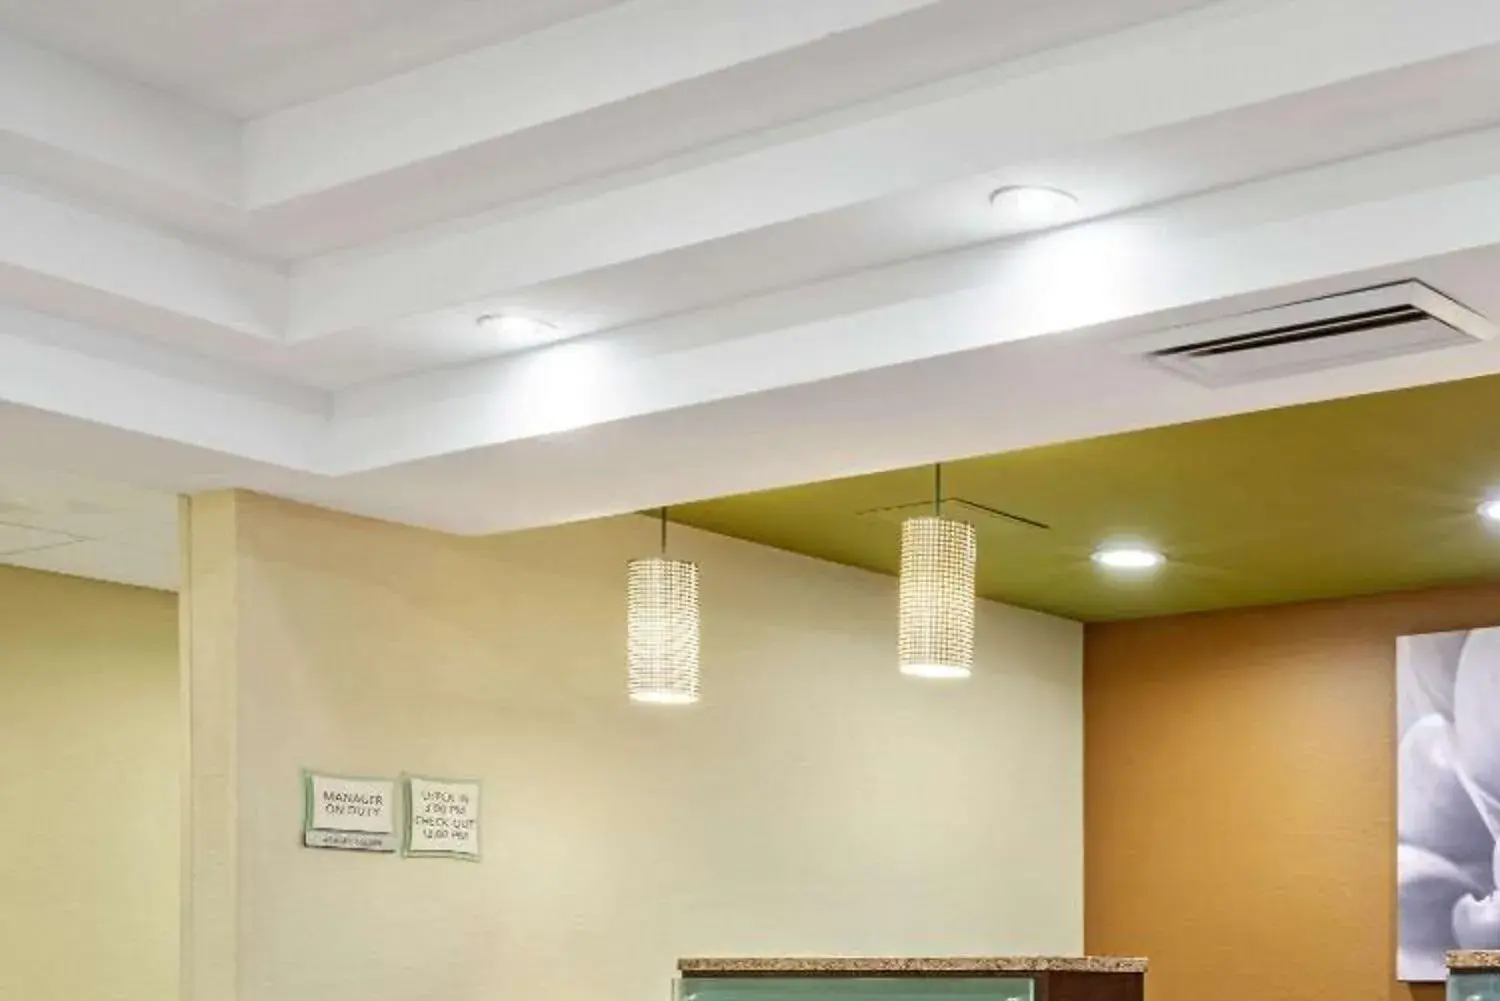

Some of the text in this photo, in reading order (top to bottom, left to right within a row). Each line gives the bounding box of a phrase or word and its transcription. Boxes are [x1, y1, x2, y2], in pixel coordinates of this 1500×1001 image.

[323, 791, 383, 805] MANAGER
[325, 803, 382, 817] ON DUTY
